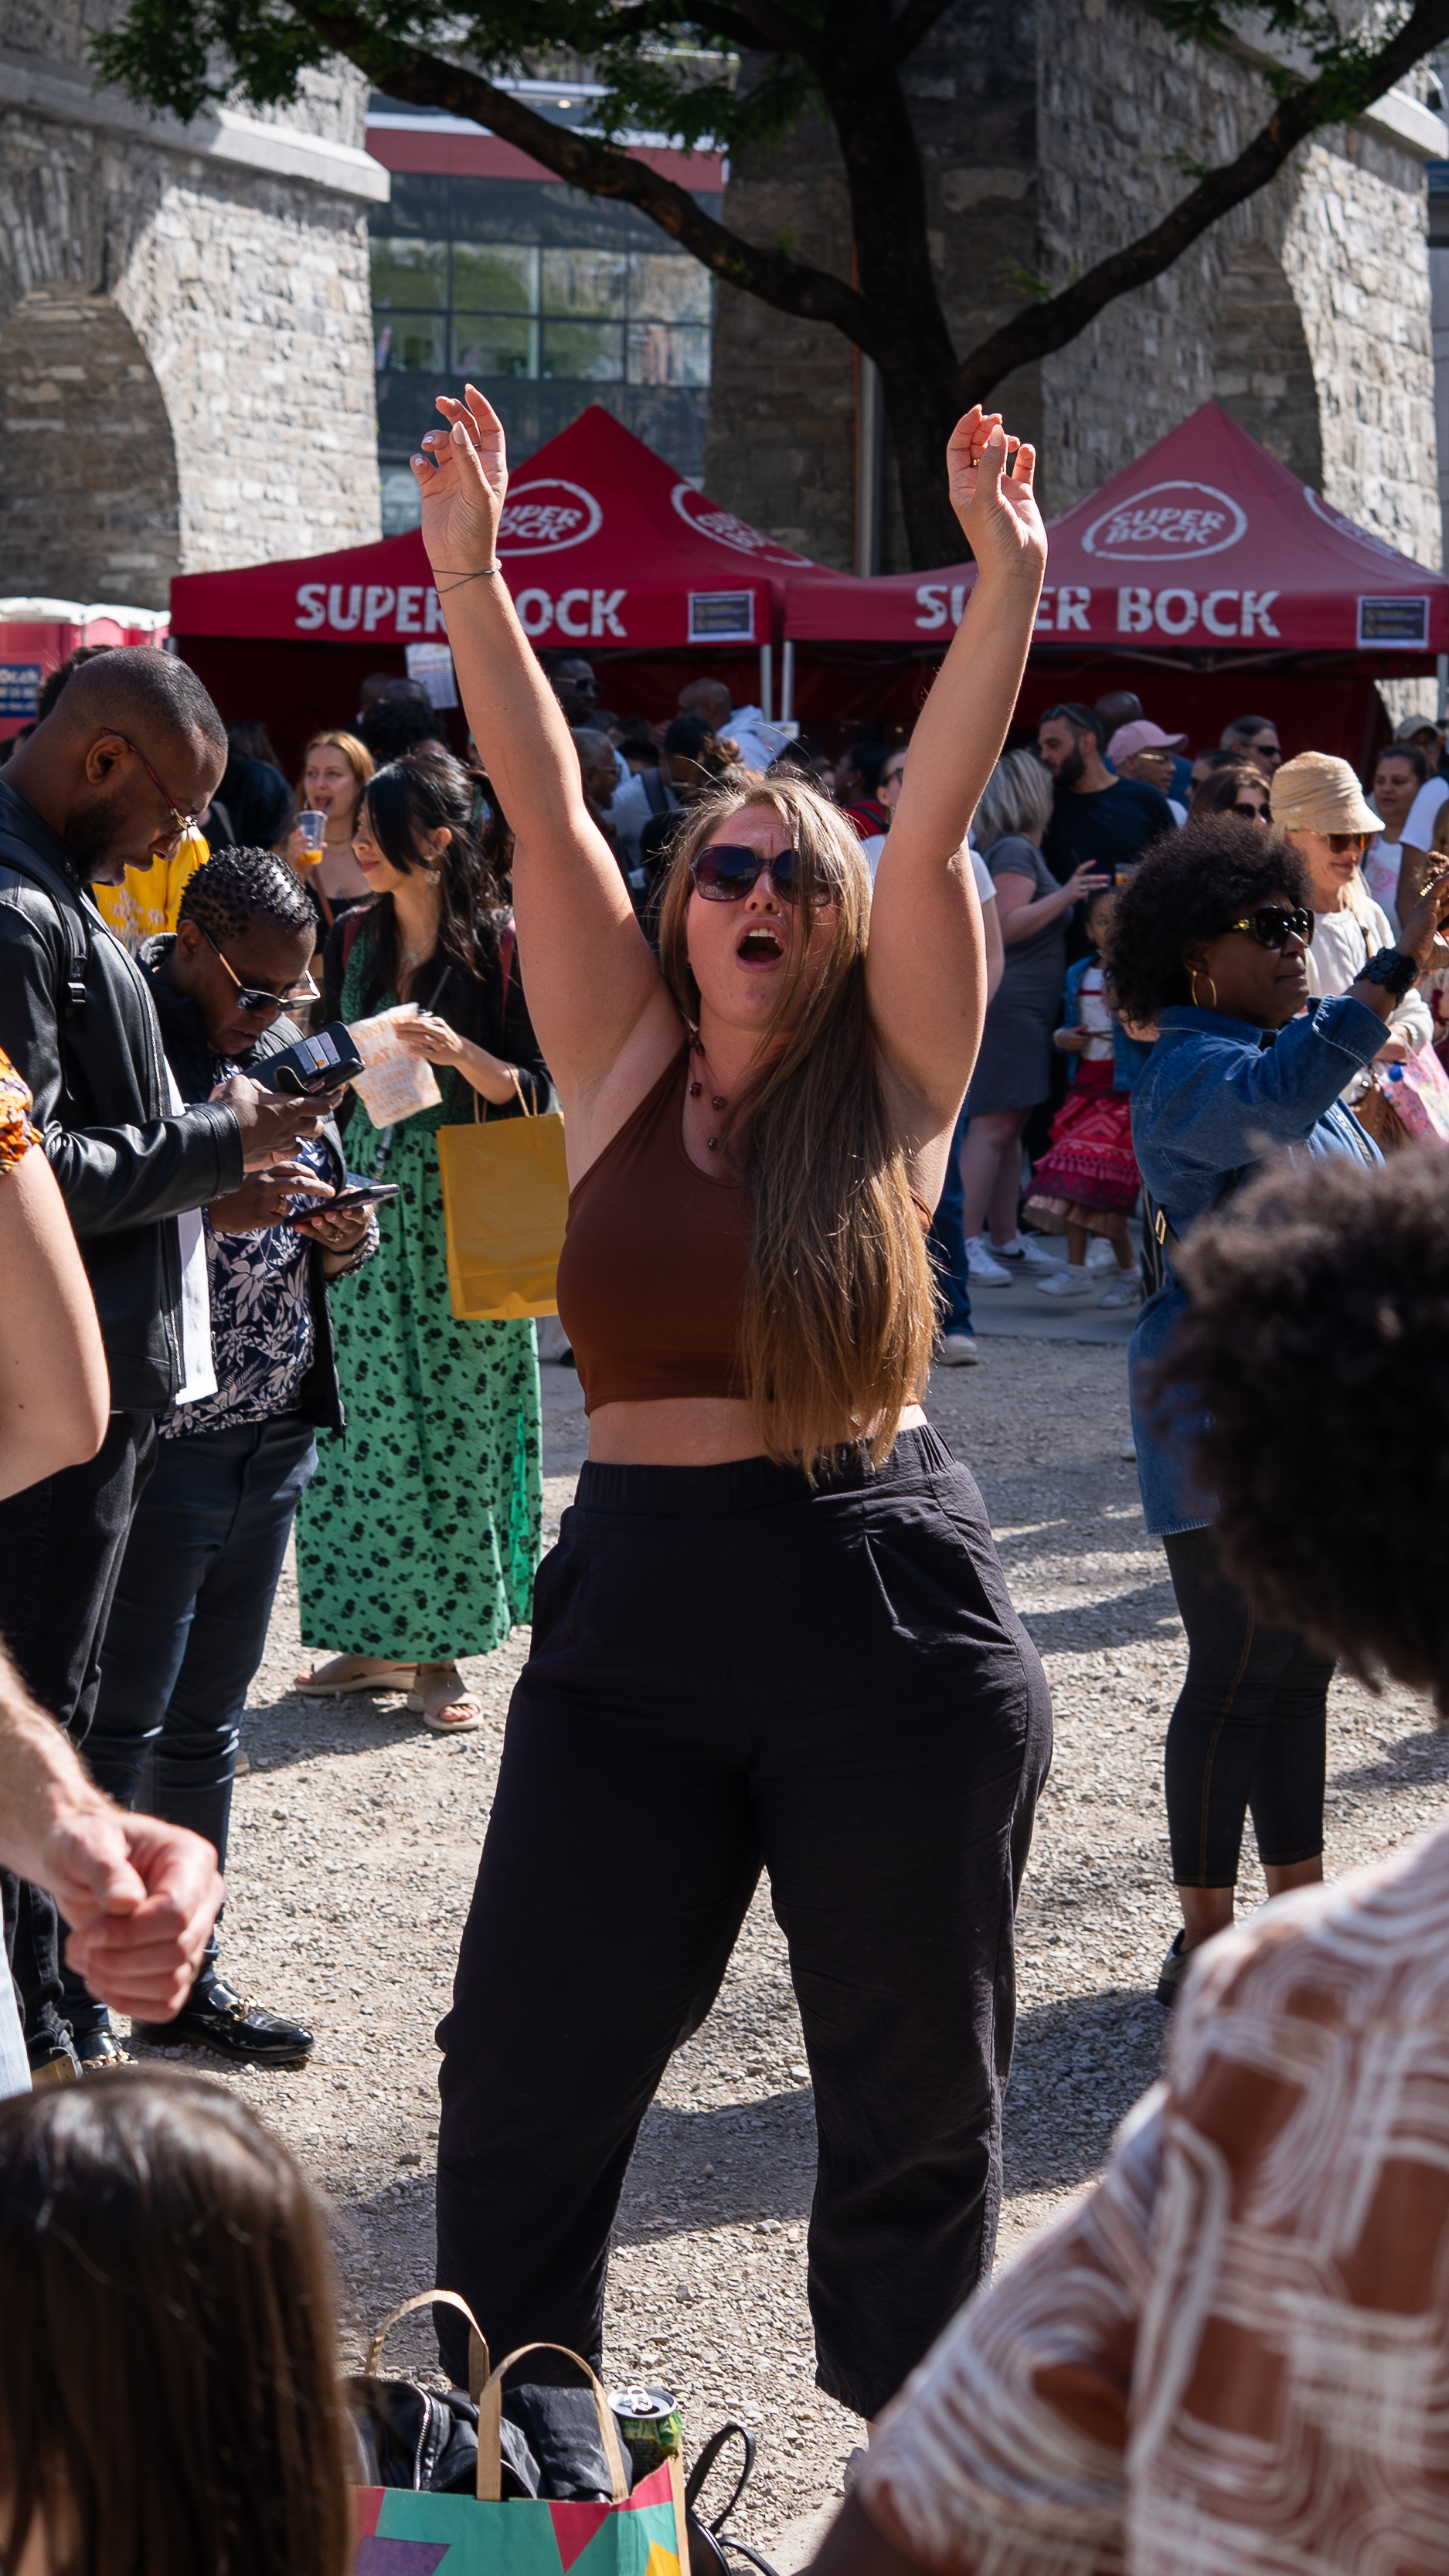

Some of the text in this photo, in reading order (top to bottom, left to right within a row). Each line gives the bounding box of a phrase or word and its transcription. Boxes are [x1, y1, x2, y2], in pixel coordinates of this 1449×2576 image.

[500, 505, 583, 527] UPER
[1112, 507, 1226, 530] SUPER
[497, 521, 567, 541] OCK
[1105, 523, 1213, 545] BOCK
[515, 587, 628, 637] OCK
[1117, 586, 1281, 637] BOCK
